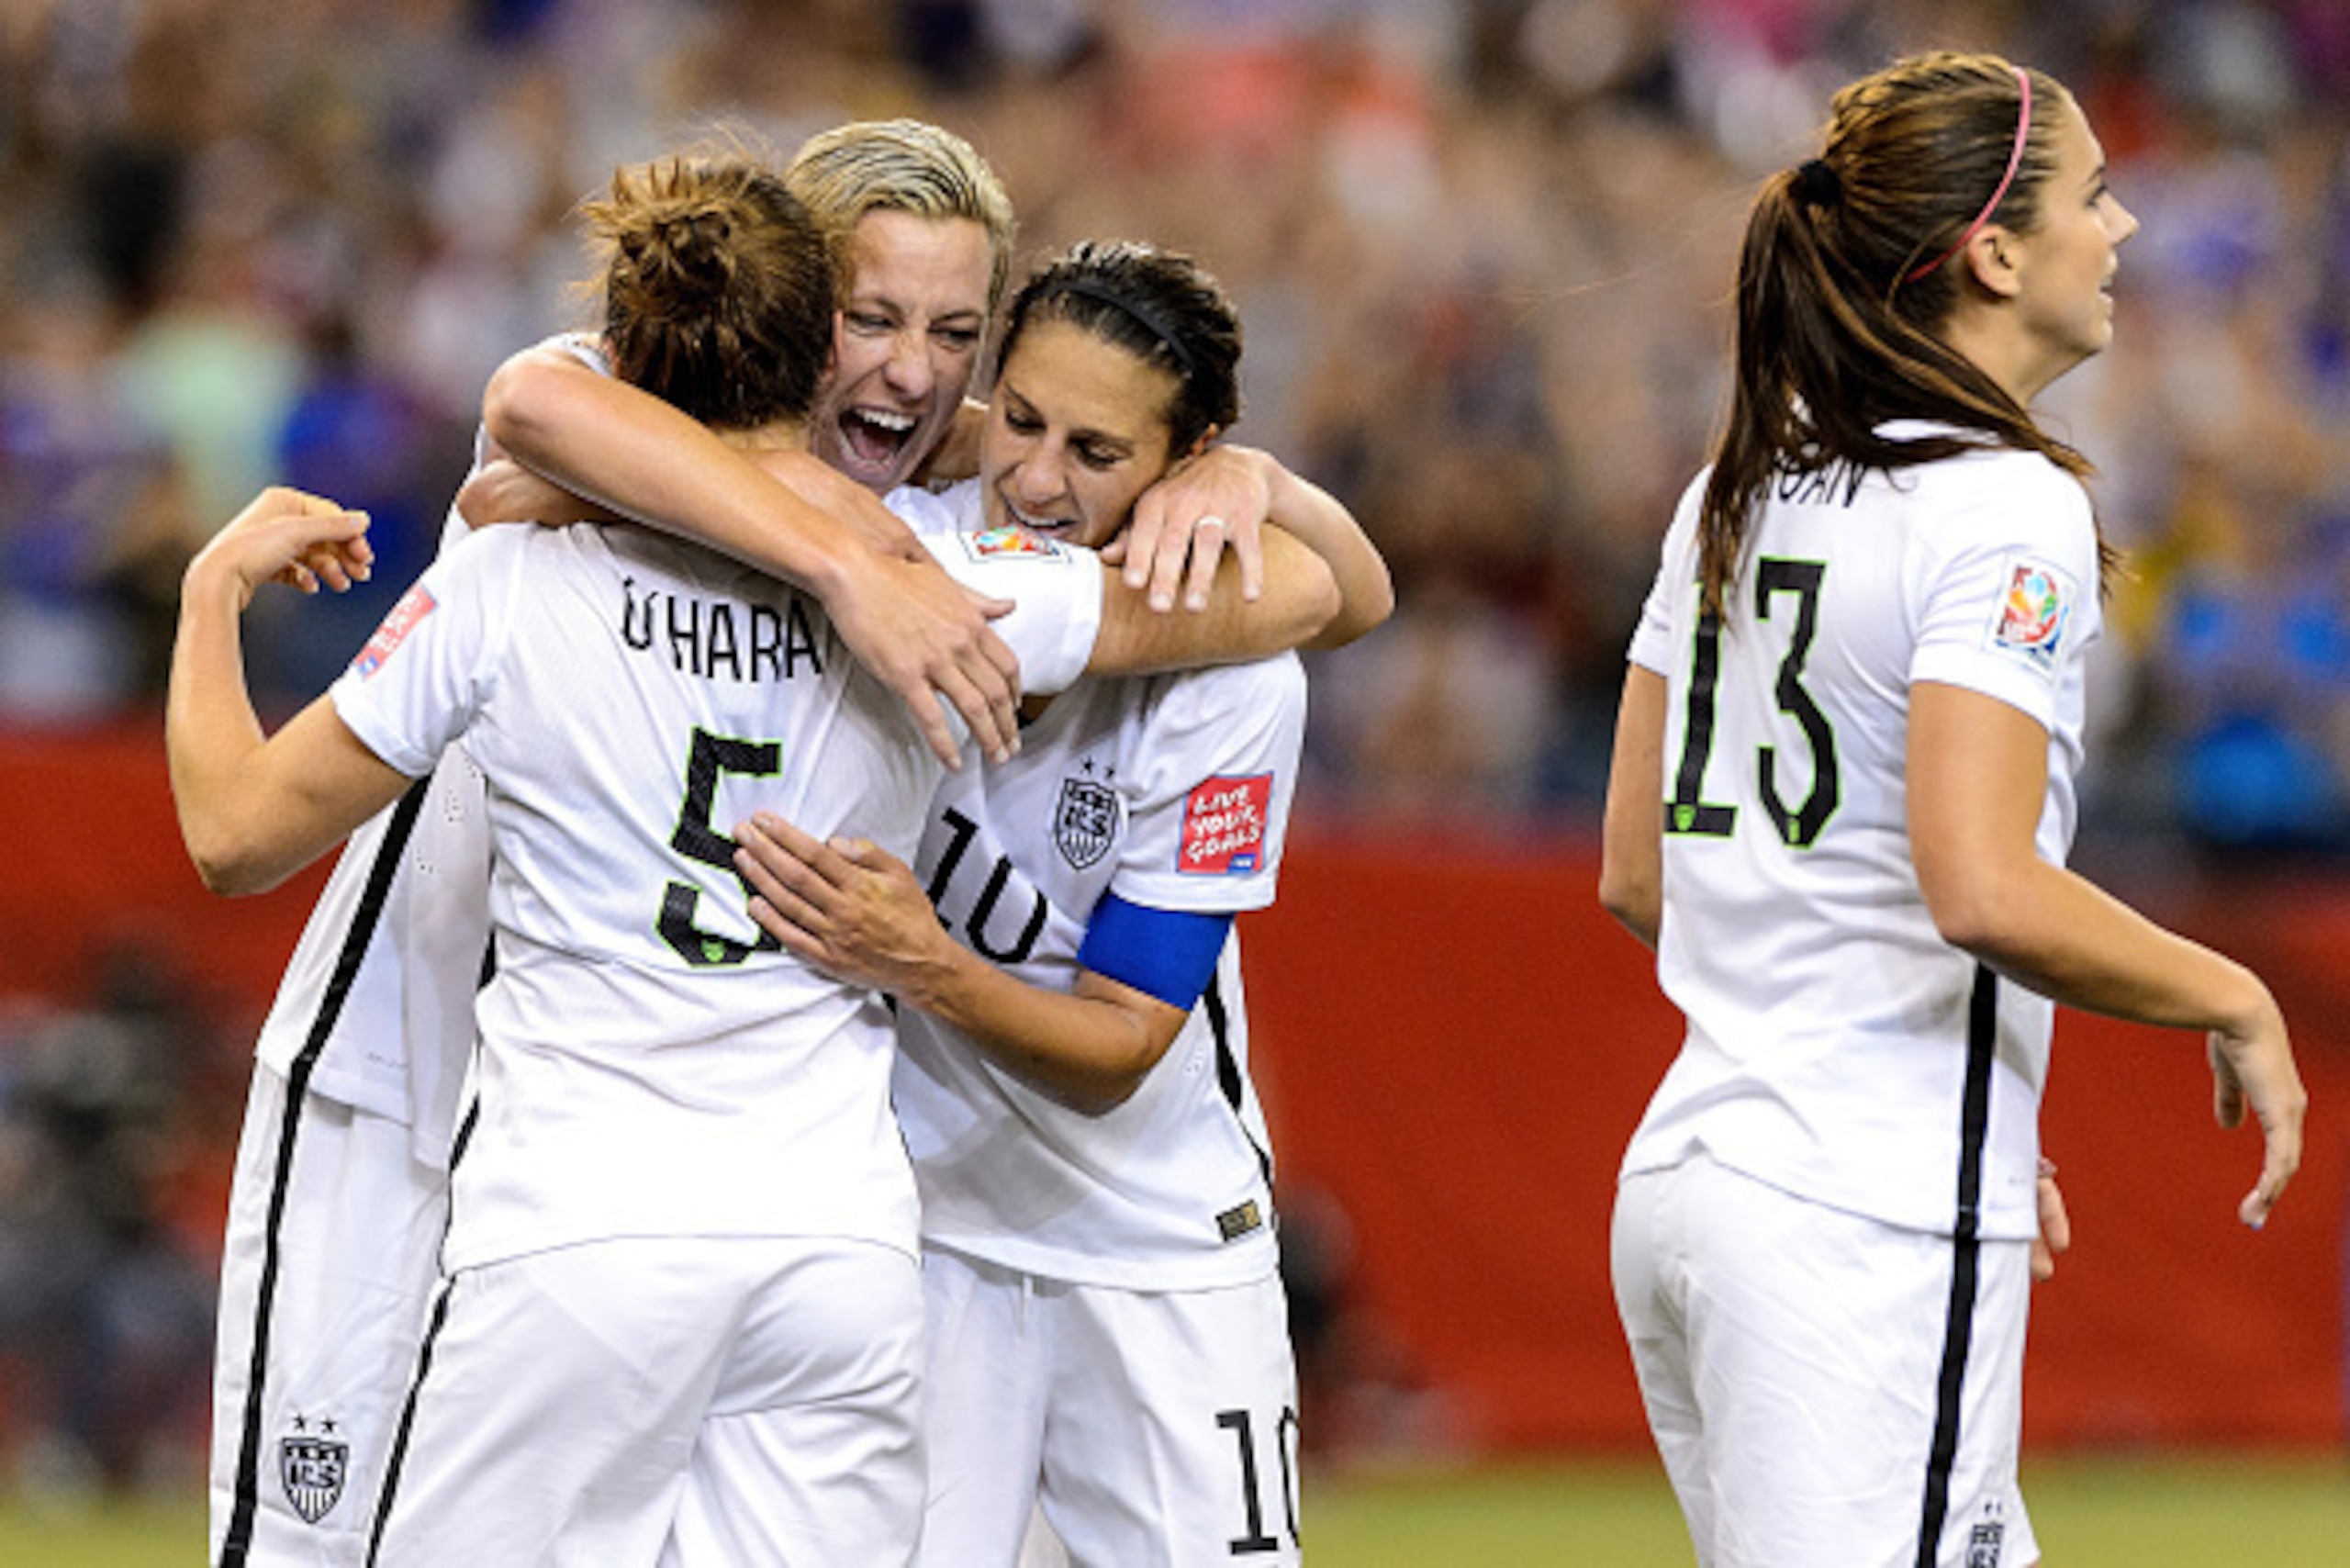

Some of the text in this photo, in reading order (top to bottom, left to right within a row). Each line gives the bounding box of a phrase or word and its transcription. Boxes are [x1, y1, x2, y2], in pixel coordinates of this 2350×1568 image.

[1663, 555, 1841, 850] 13
[655, 722, 782, 967] 5
[1186, 825, 1261, 865] GOALS
[1190, 804, 1264, 838] YOUR
[1194, 784, 1250, 816] LIVE
[925, 806, 1048, 964] 10
